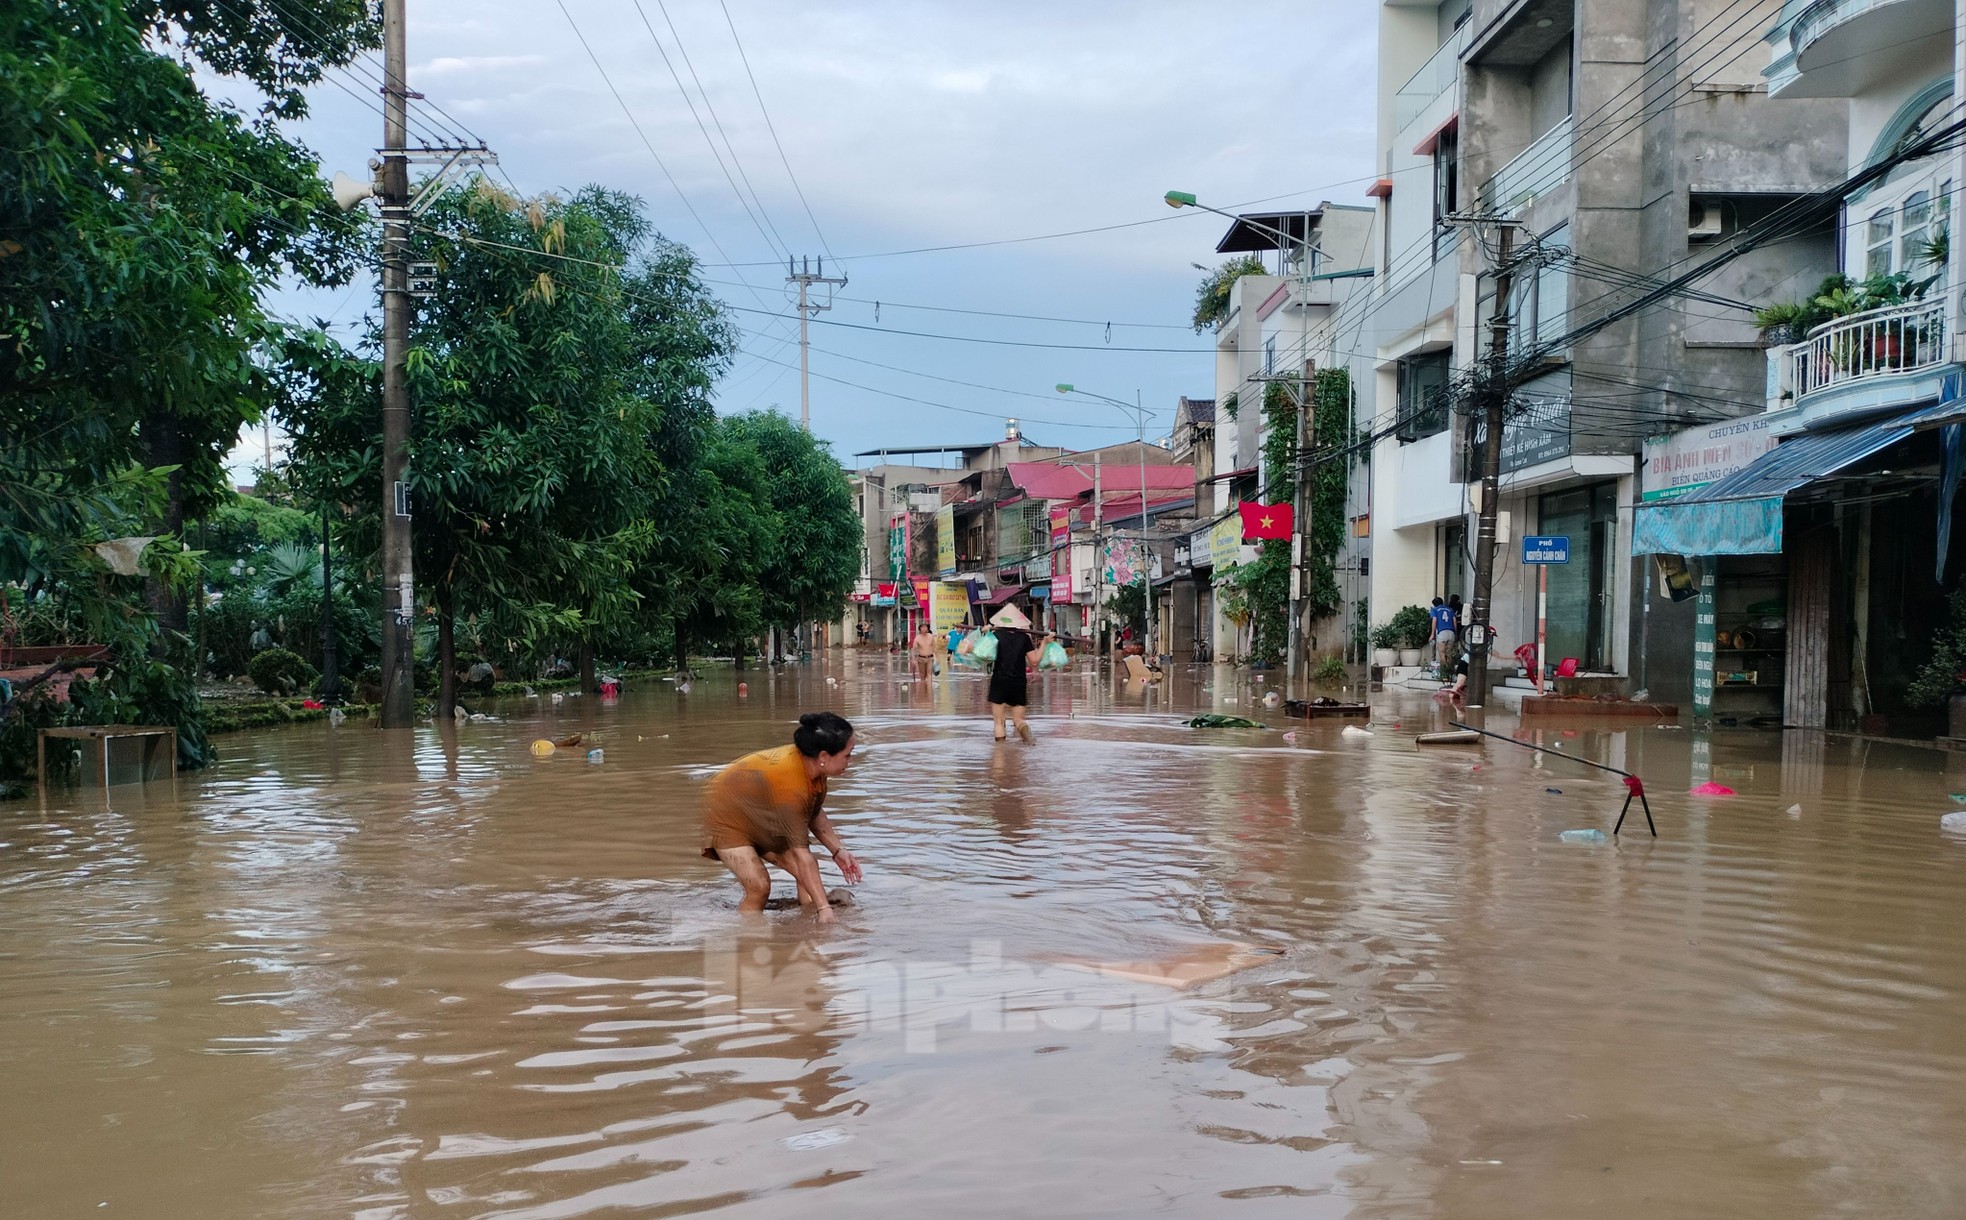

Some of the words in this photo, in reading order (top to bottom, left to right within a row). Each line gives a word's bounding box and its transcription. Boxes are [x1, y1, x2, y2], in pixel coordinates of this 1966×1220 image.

[1708, 421, 1750, 440] CHUYÊN
[1653, 455, 1672, 474] BIA
[1538, 539, 1553, 547] PHỐ
[1442, 611, 1449, 622] 4
